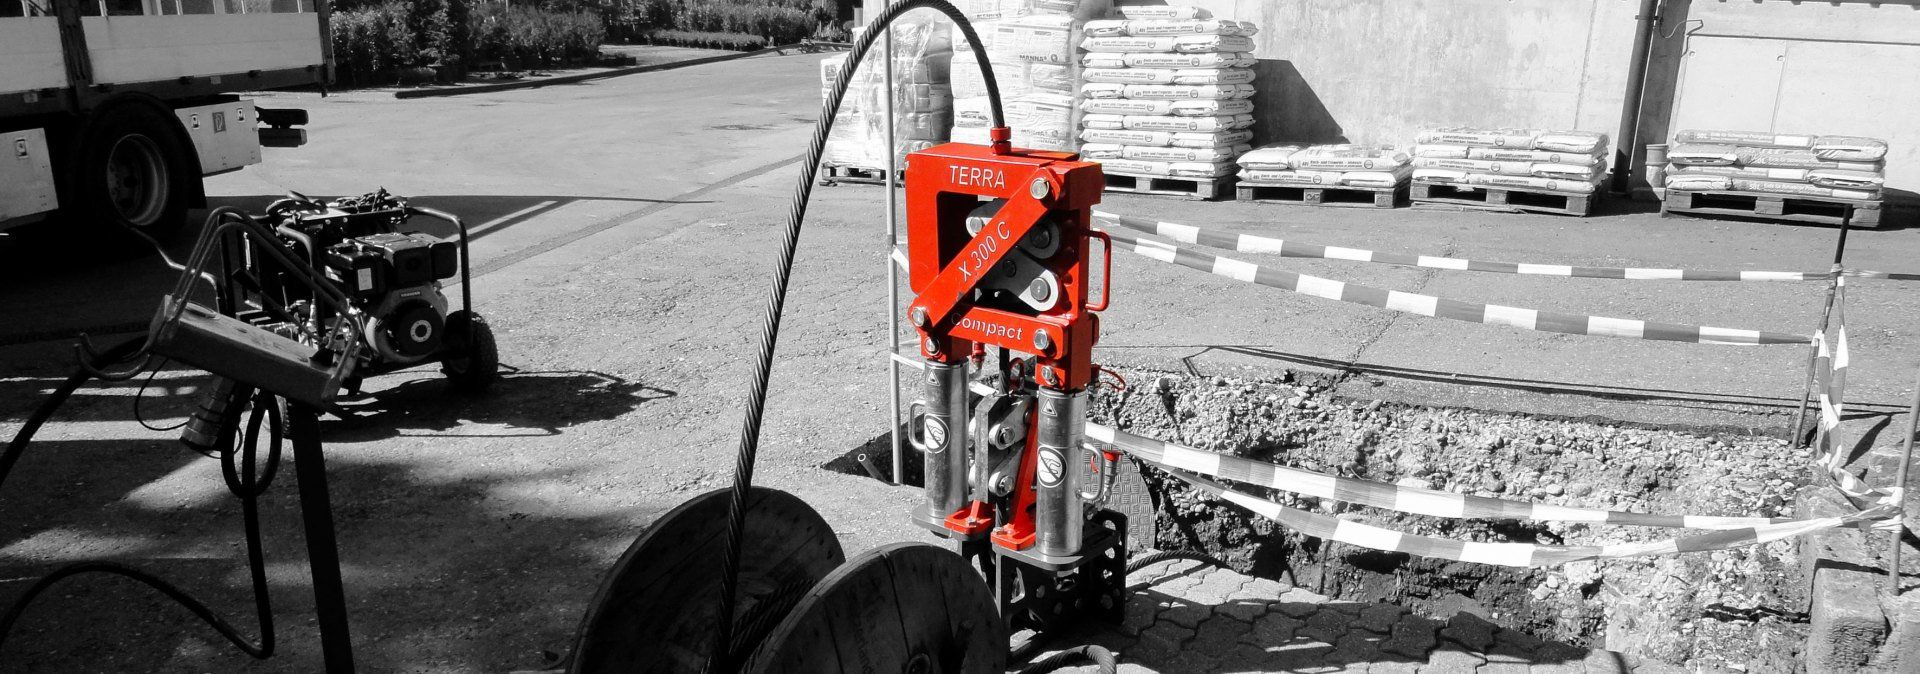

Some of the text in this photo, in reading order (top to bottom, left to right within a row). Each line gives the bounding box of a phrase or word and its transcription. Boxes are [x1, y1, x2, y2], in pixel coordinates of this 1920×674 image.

[949, 165, 1005, 189] TERRA
[958, 221, 1010, 282] X 300 C
